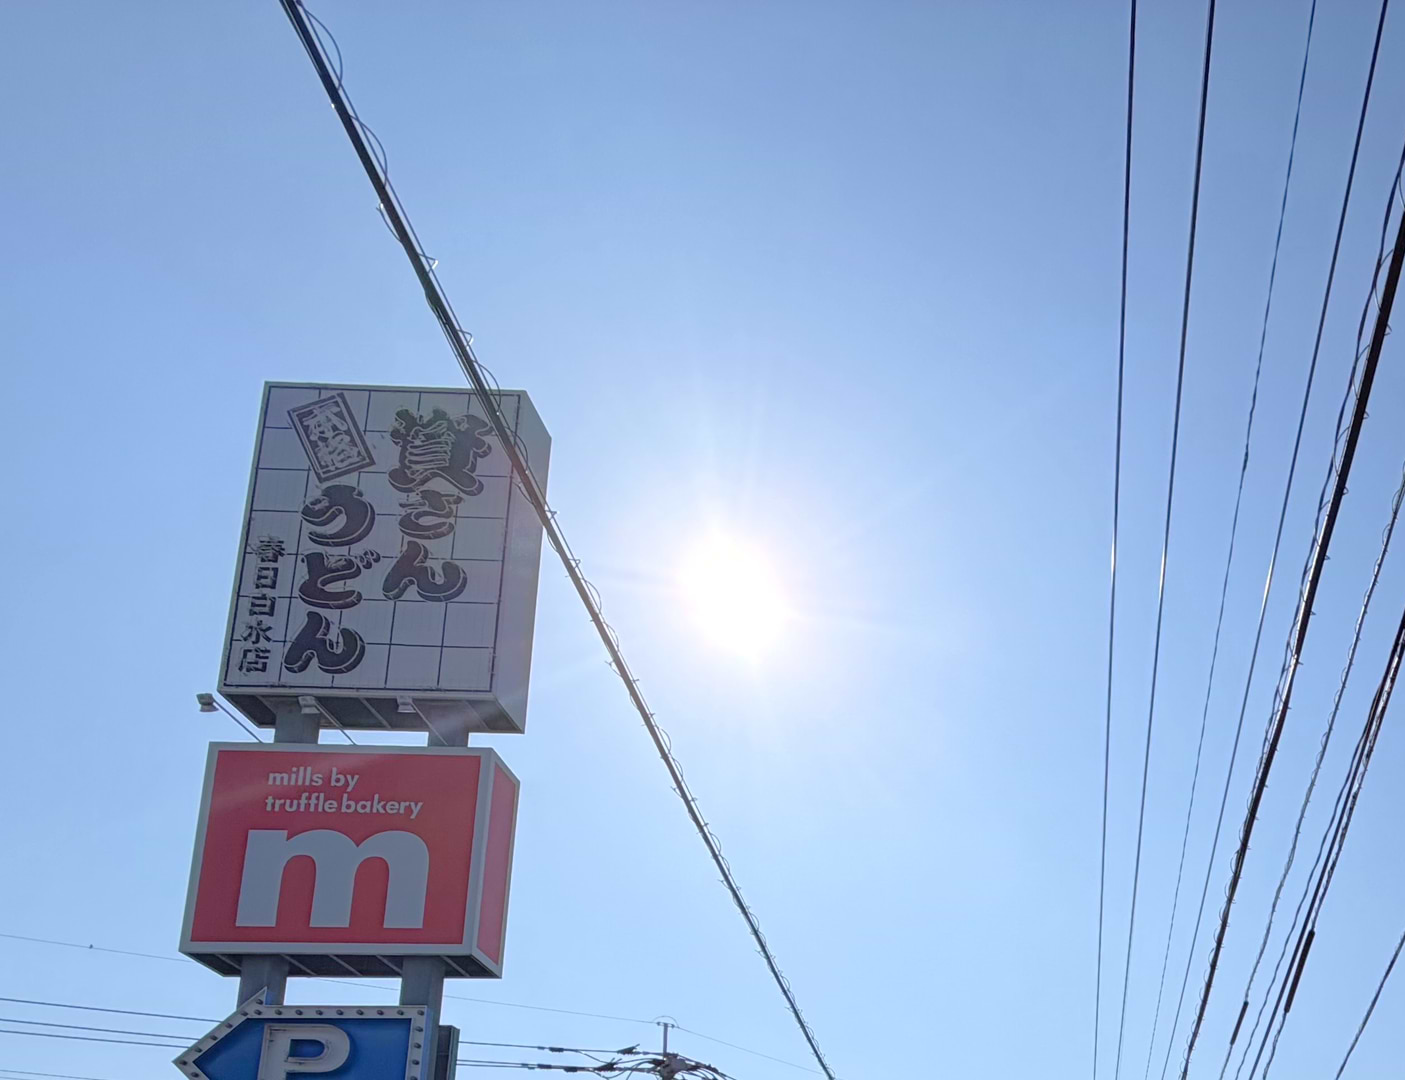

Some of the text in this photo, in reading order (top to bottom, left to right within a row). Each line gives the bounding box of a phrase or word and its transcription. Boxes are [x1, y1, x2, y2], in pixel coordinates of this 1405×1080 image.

[382, 404, 496, 602] 資さん
[283, 483, 381, 674] うどん
[265, 793, 423, 818] truffle bakery
[268, 767, 359, 793] mills by
[235, 828, 430, 929] m
